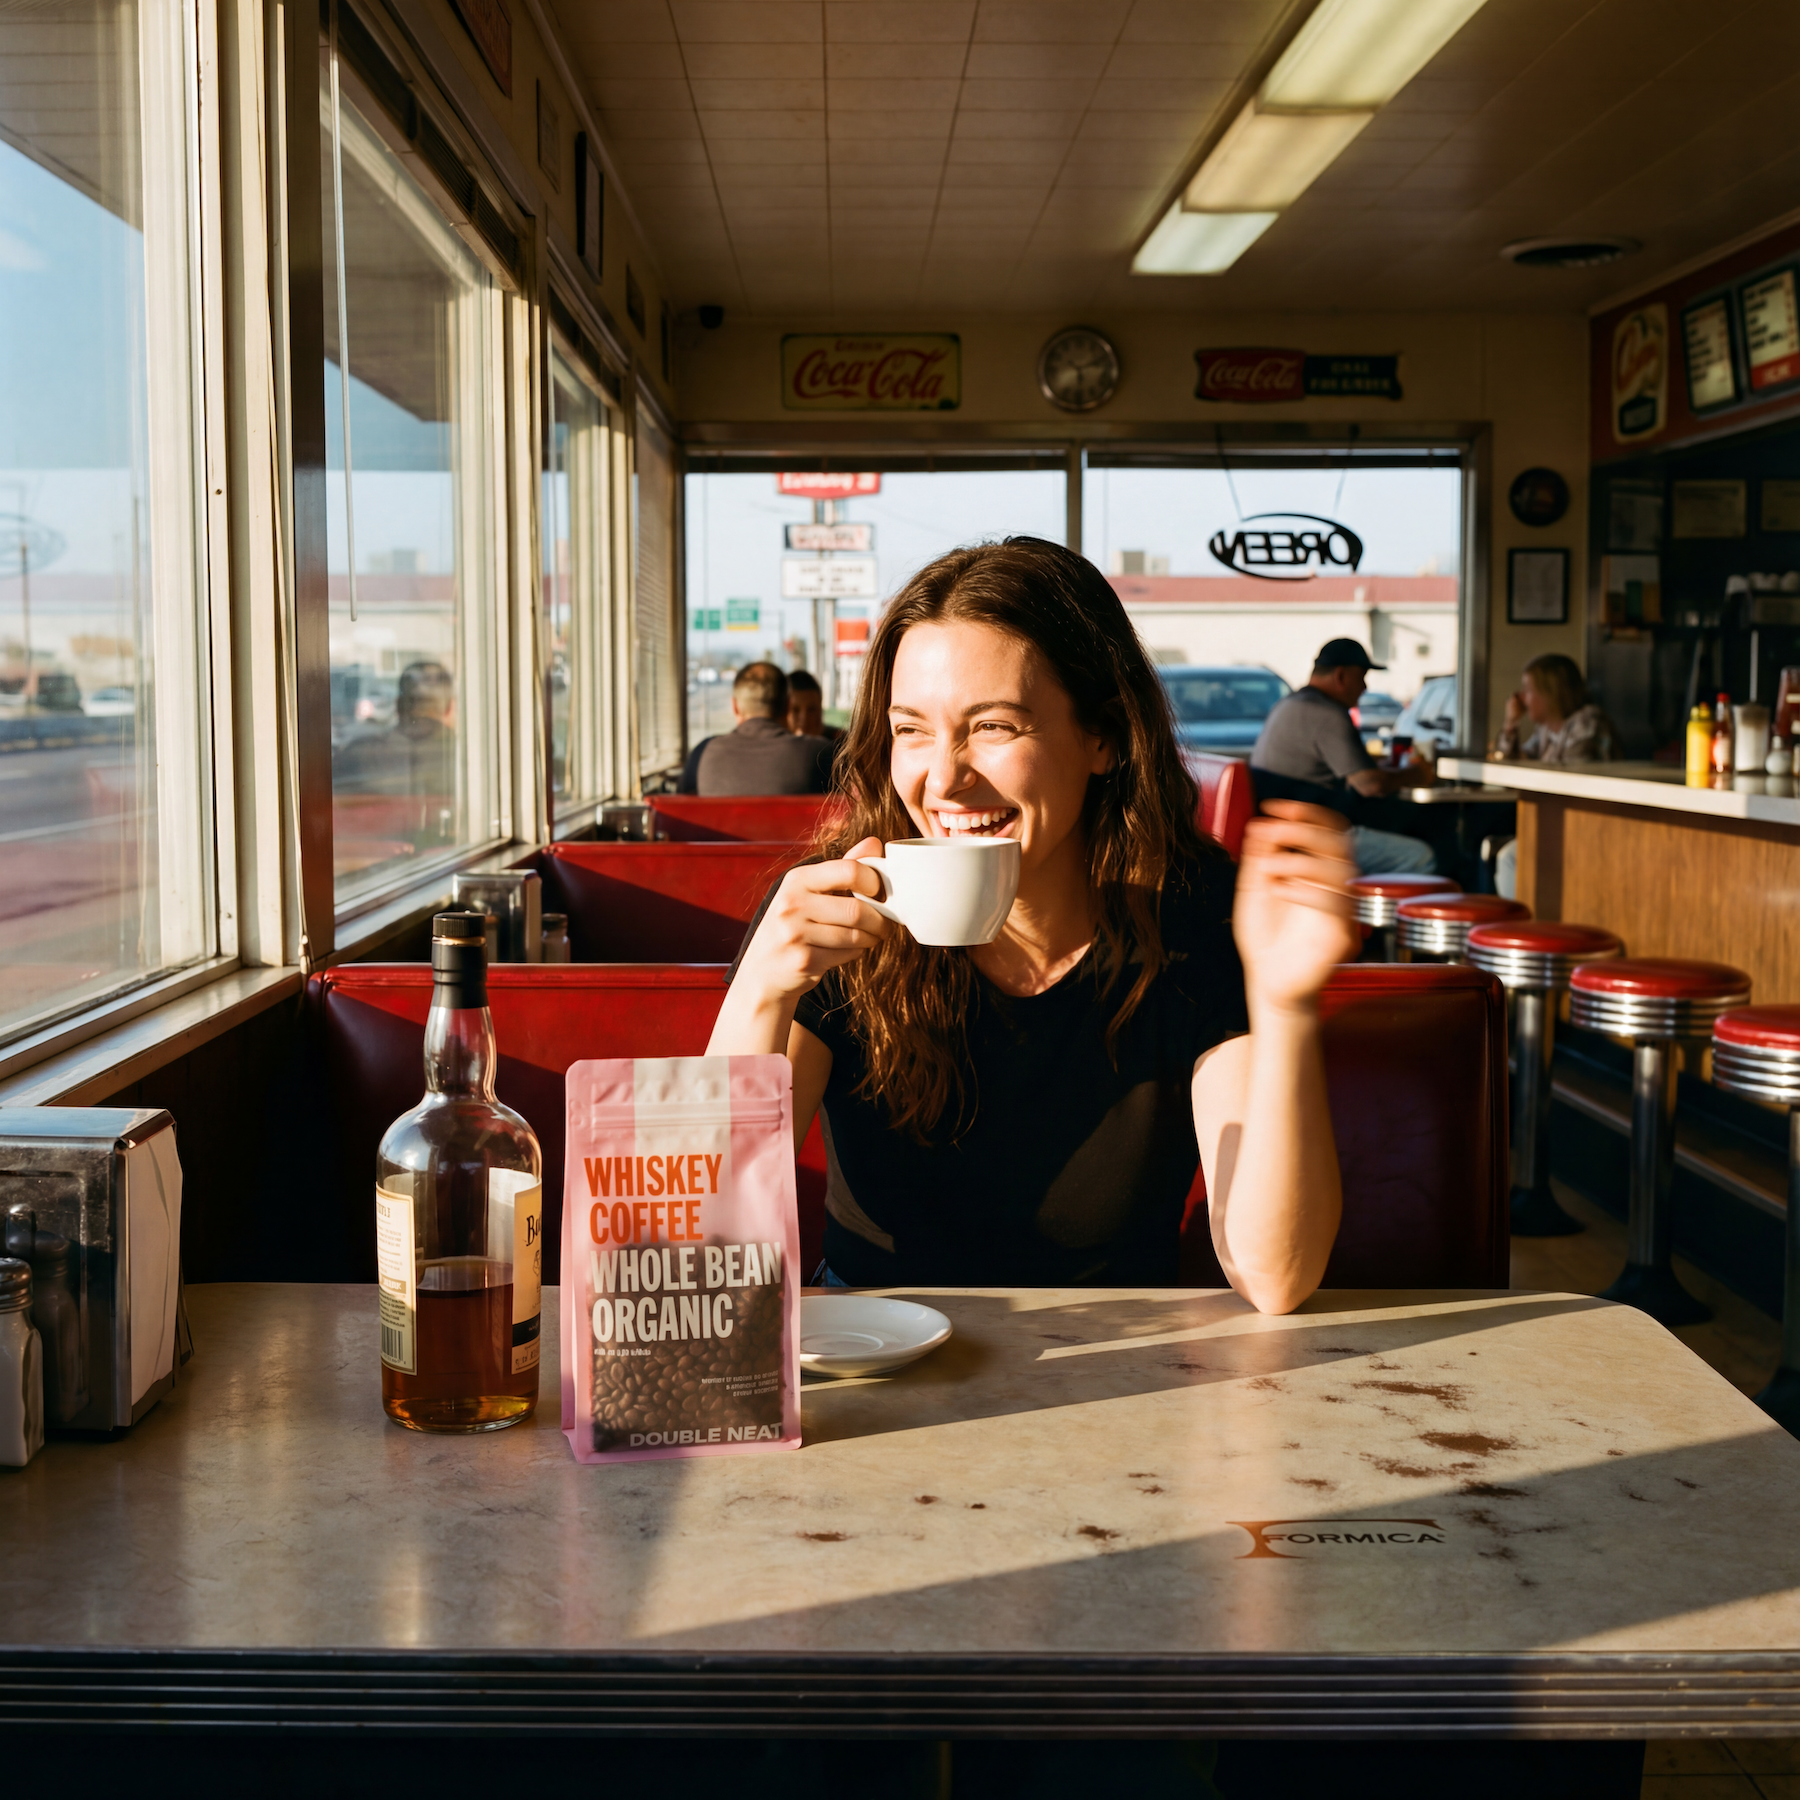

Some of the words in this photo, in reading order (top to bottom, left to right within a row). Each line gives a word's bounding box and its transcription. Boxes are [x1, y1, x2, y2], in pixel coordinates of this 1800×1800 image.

[584, 1153, 723, 1197] WHISKEY
[589, 1200, 704, 1245] COFFEE
[590, 1246, 698, 1294] WHOLE
[704, 1241, 782, 1289] BEAN
[592, 1293, 734, 1343] ORGANIC
[630, 1427, 722, 1448] DOUBLE
[727, 1421, 782, 1441] NEAT
